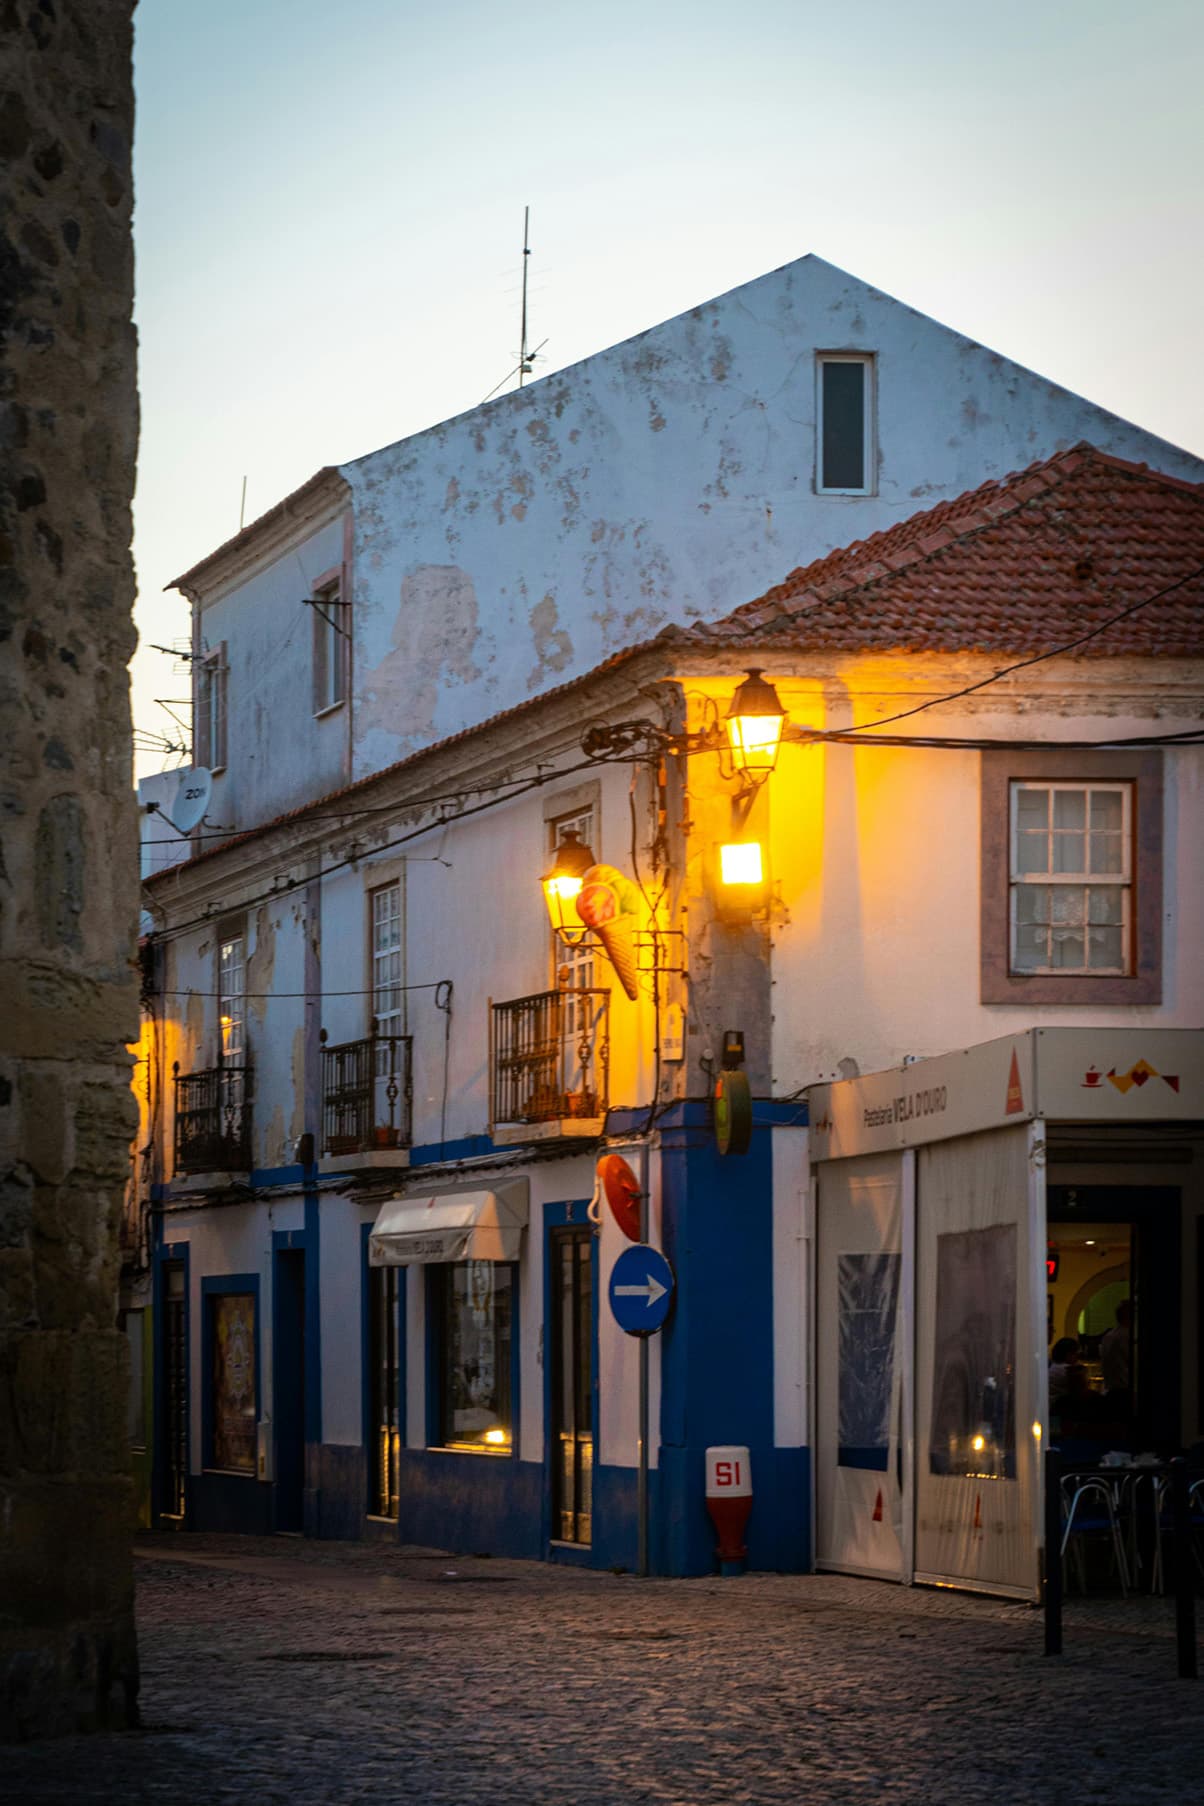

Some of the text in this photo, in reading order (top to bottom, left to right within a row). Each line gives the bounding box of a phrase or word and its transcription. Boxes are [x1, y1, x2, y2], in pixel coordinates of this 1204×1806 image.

[893, 1096, 914, 1123] VELA
[916, 1086, 947, 1118] D'OURO
[716, 1461, 741, 1486] SI
